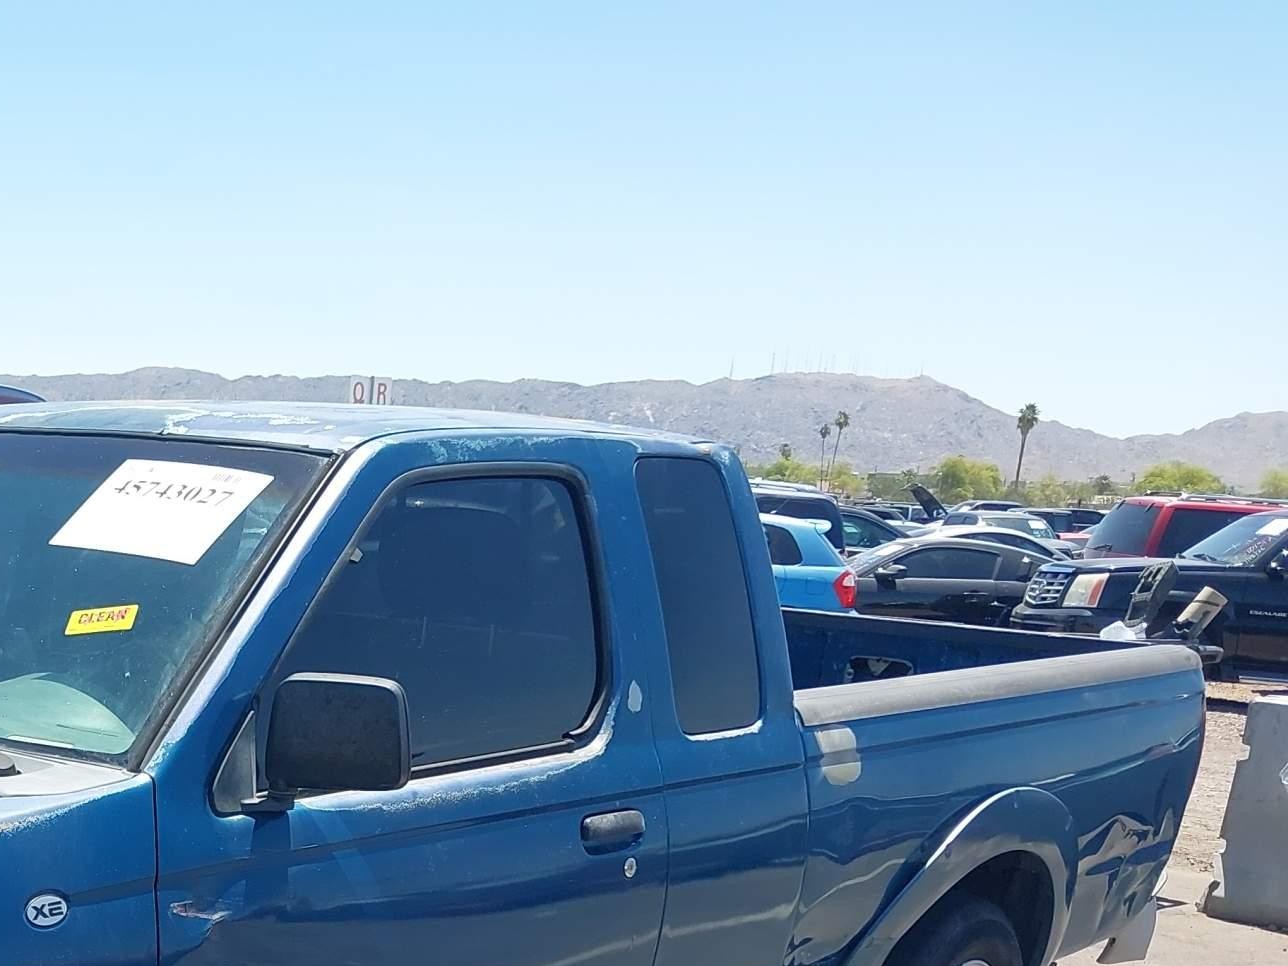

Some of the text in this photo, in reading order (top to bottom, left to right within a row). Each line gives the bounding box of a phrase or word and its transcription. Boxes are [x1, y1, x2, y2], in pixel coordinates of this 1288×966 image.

[377, 382, 387, 405] R
[114, 479, 235, 506] 45743027
[78, 608, 131, 624] CLEAN
[31, 900, 64, 921] XE
